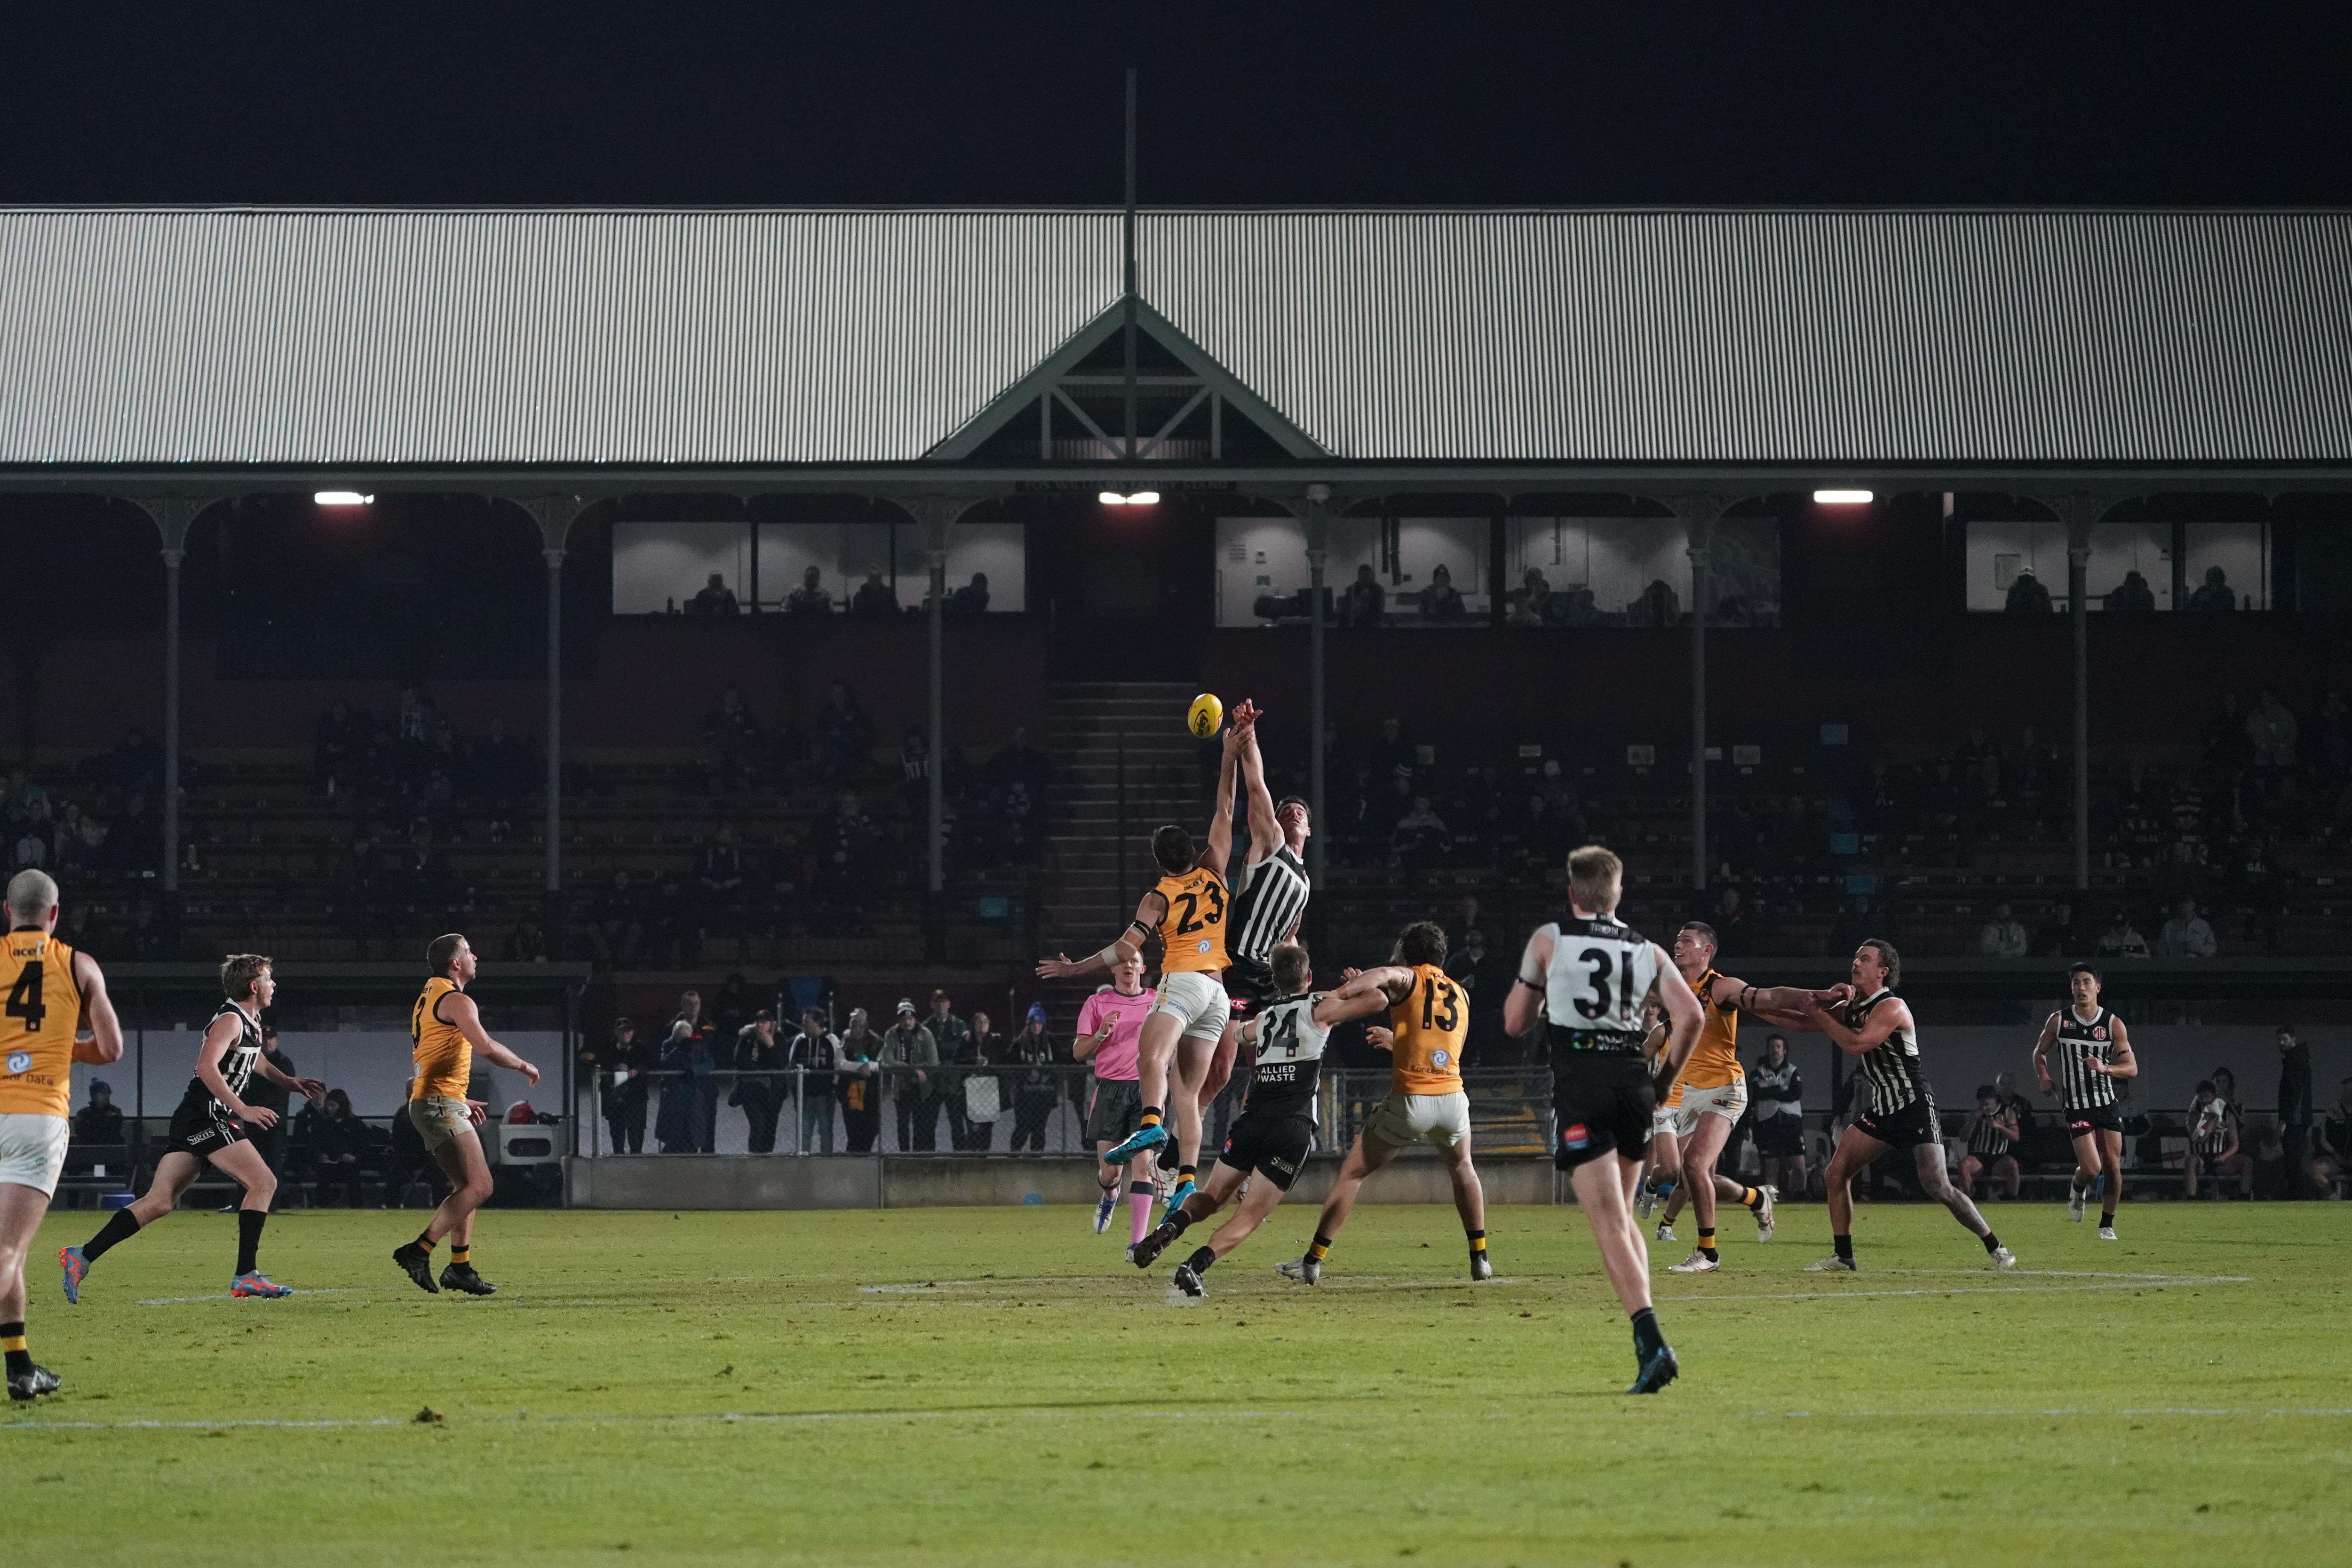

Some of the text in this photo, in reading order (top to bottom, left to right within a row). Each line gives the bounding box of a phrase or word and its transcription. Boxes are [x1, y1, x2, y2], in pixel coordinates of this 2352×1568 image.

[1174, 881, 1224, 936] 23
[1573, 948, 1634, 1021] 31
[5, 961, 46, 1031] 4
[1422, 978, 1458, 1032] 13
[1257, 1008, 1299, 1058] 34
[2094, 1027, 2106, 1040] MG
[1261, 1065, 1295, 1074] ALLIED
[1411, 1065, 1445, 1075] Concept
[26, 1075, 53, 1086] Data
[1261, 1073, 1295, 1082] WASTE
[187, 1130, 215, 1145] Signs
